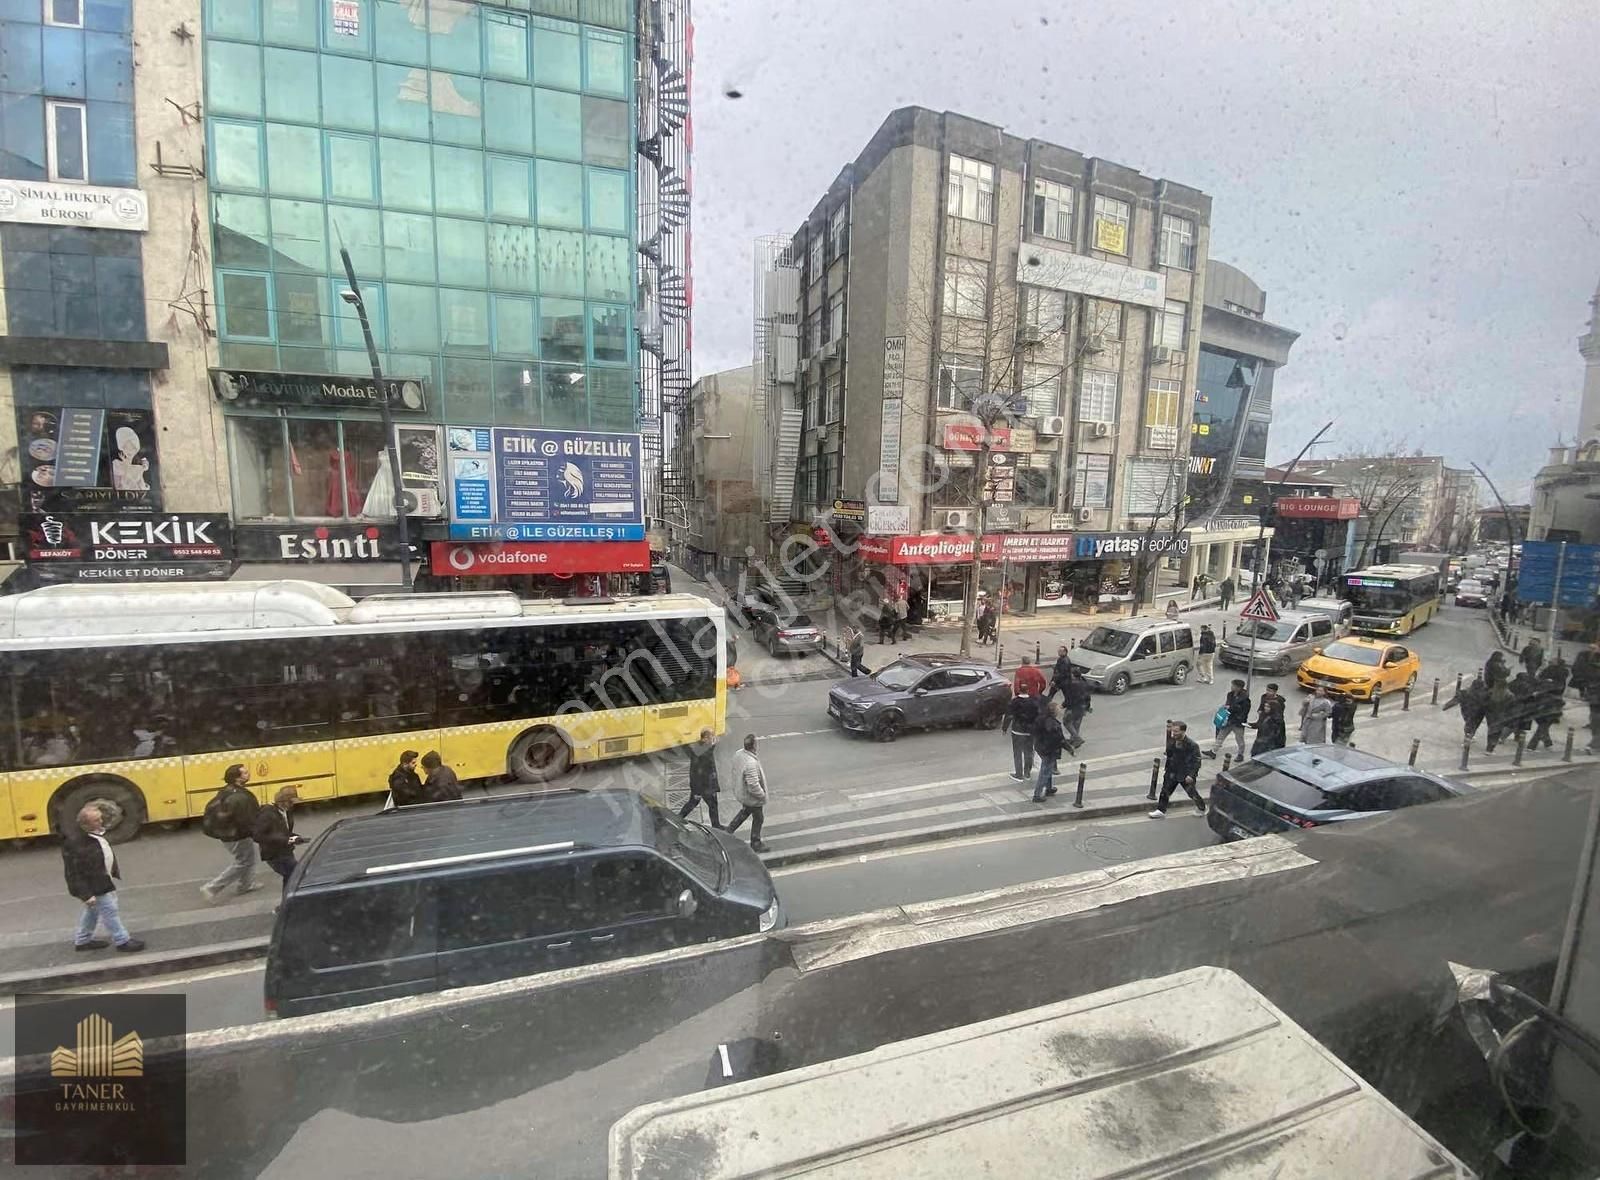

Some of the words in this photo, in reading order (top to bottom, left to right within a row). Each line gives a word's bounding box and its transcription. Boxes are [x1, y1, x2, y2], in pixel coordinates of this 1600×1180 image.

[64, 193, 112, 204] HUKUK
[41, 208, 93, 220] BÜROSU
[322, 383, 366, 398] Moda
[503, 435, 536, 453] ETİK
[541, 440, 559, 456] @
[564, 437, 632, 457] GÜZELLİK
[1298, 504, 1336, 512] LOUNGE
[90, 516, 214, 545] KEKİK
[471, 525, 502, 537] ETİK
[506, 527, 520, 539] @
[523, 525, 543, 537] İLE
[547, 526, 614, 539] GÜZELLEŞ
[279, 527, 381, 558] Esinti
[1004, 535, 1029, 546] İMREN
[1040, 537, 1069, 546] MARKET
[1095, 536, 1139, 557] yataş
[94, 547, 148, 560] DÖNER
[479, 550, 547, 564] vodafone
[79, 567, 123, 578] KEKİK
[125, 569, 140, 577] ET
[143, 567, 184, 577] DÖNER
